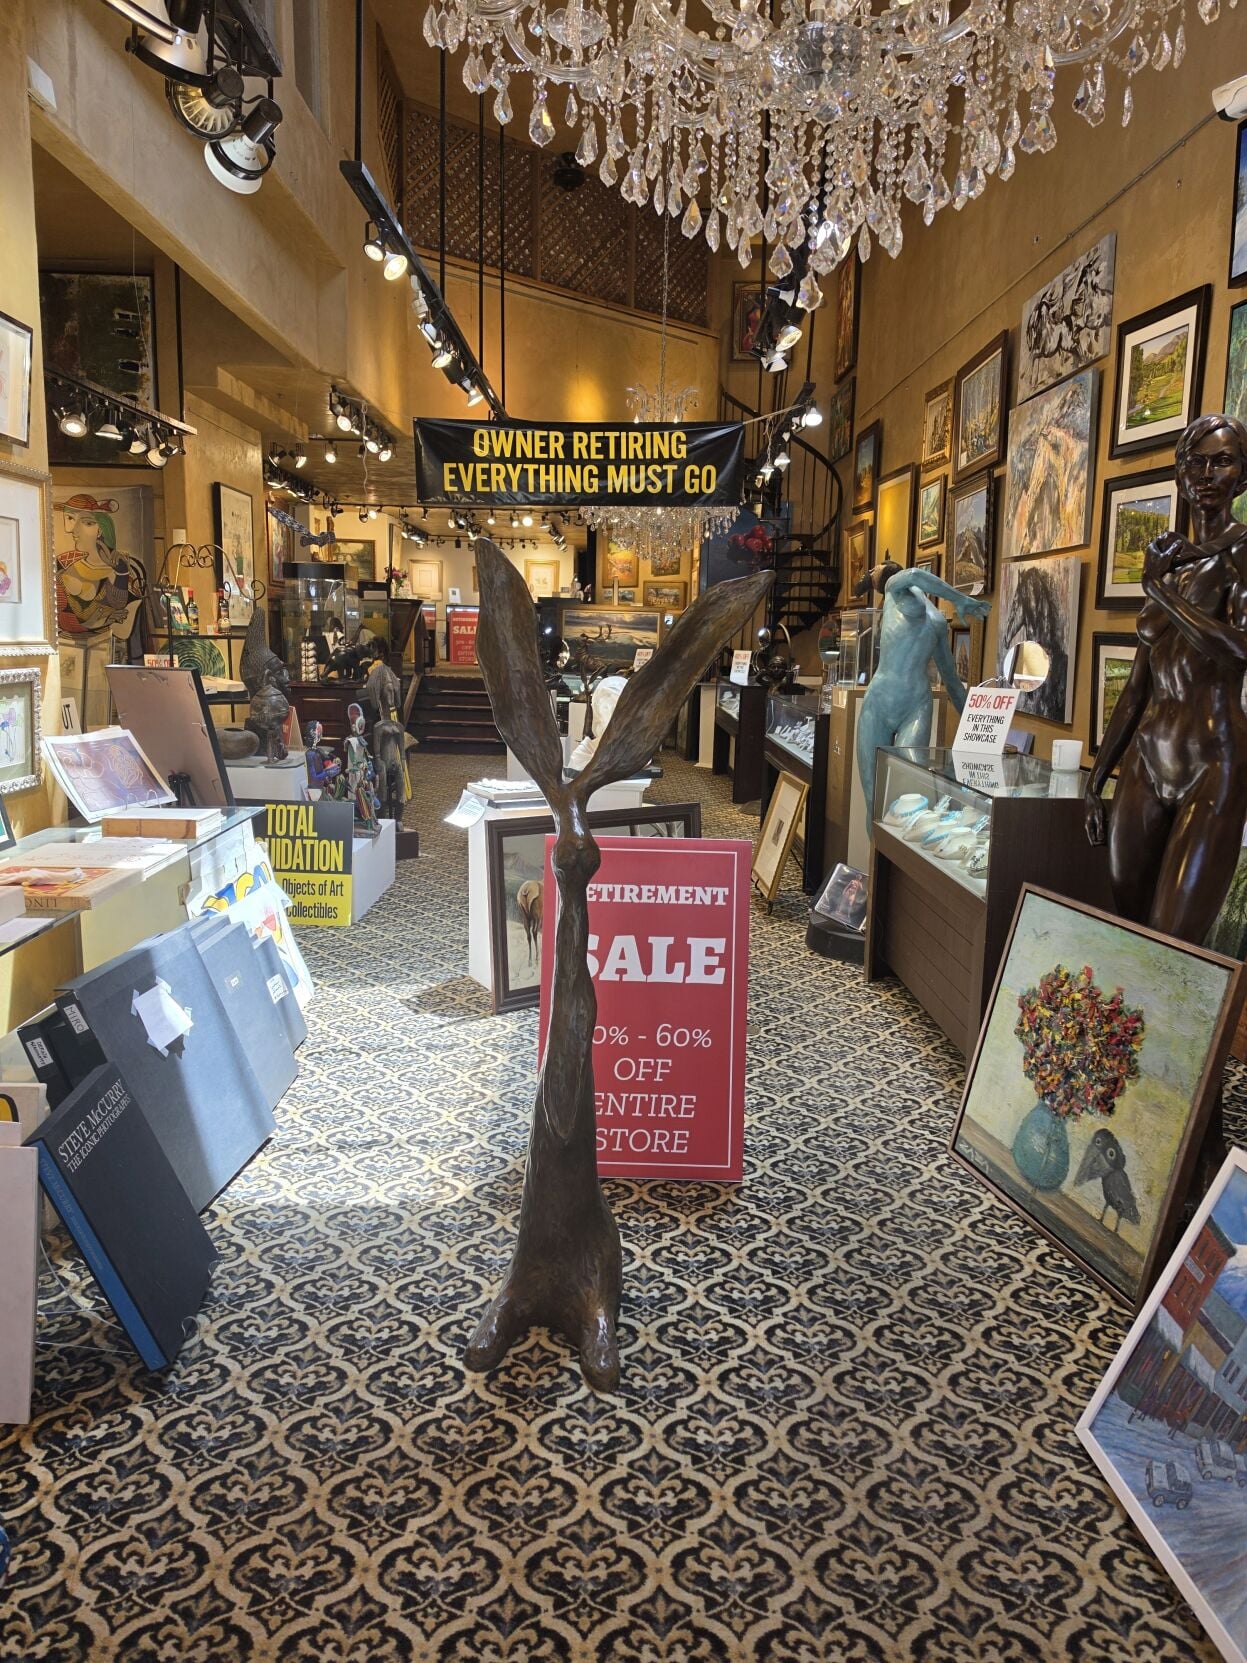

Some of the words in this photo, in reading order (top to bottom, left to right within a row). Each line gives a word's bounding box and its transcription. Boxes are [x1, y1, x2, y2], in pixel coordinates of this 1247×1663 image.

[473, 429, 564, 459] OWNER
[572, 430, 687, 459] RETIRING
[443, 462, 598, 493] EVERYTHING
[607, 464, 677, 494] MUST
[684, 464, 717, 494] GO
[968, 694, 991, 709] 50%
[993, 695, 1015, 710] OFF
[967, 713, 1005, 724] EVERYTHING
[972, 723, 980, 732] IN
[980, 724, 994, 733] THIS
[963, 733, 997, 743] SHOWCASE
[265, 804, 318, 837] TOTAL
[255, 837, 344, 871] UIDATION
[282, 878, 316, 898] Objects
[320, 880, 327, 896] of
[329, 880, 344, 897] Art
[586, 883, 729, 905] ETIREMENT
[286, 902, 338, 919] Collectibles
[66, 1006, 85, 1032] MIRO
[592, 1025, 629, 1045] 0%
[656, 1023, 712, 1048] 60%
[614, 1057, 672, 1081] OFF
[58, 1120, 91, 1162] STEVE
[86, 1078, 126, 1130] McCURRY
[67, 1153, 83, 1173] THE
[80, 1132, 100, 1159] ICONIC
[596, 1127, 689, 1153] STORE
